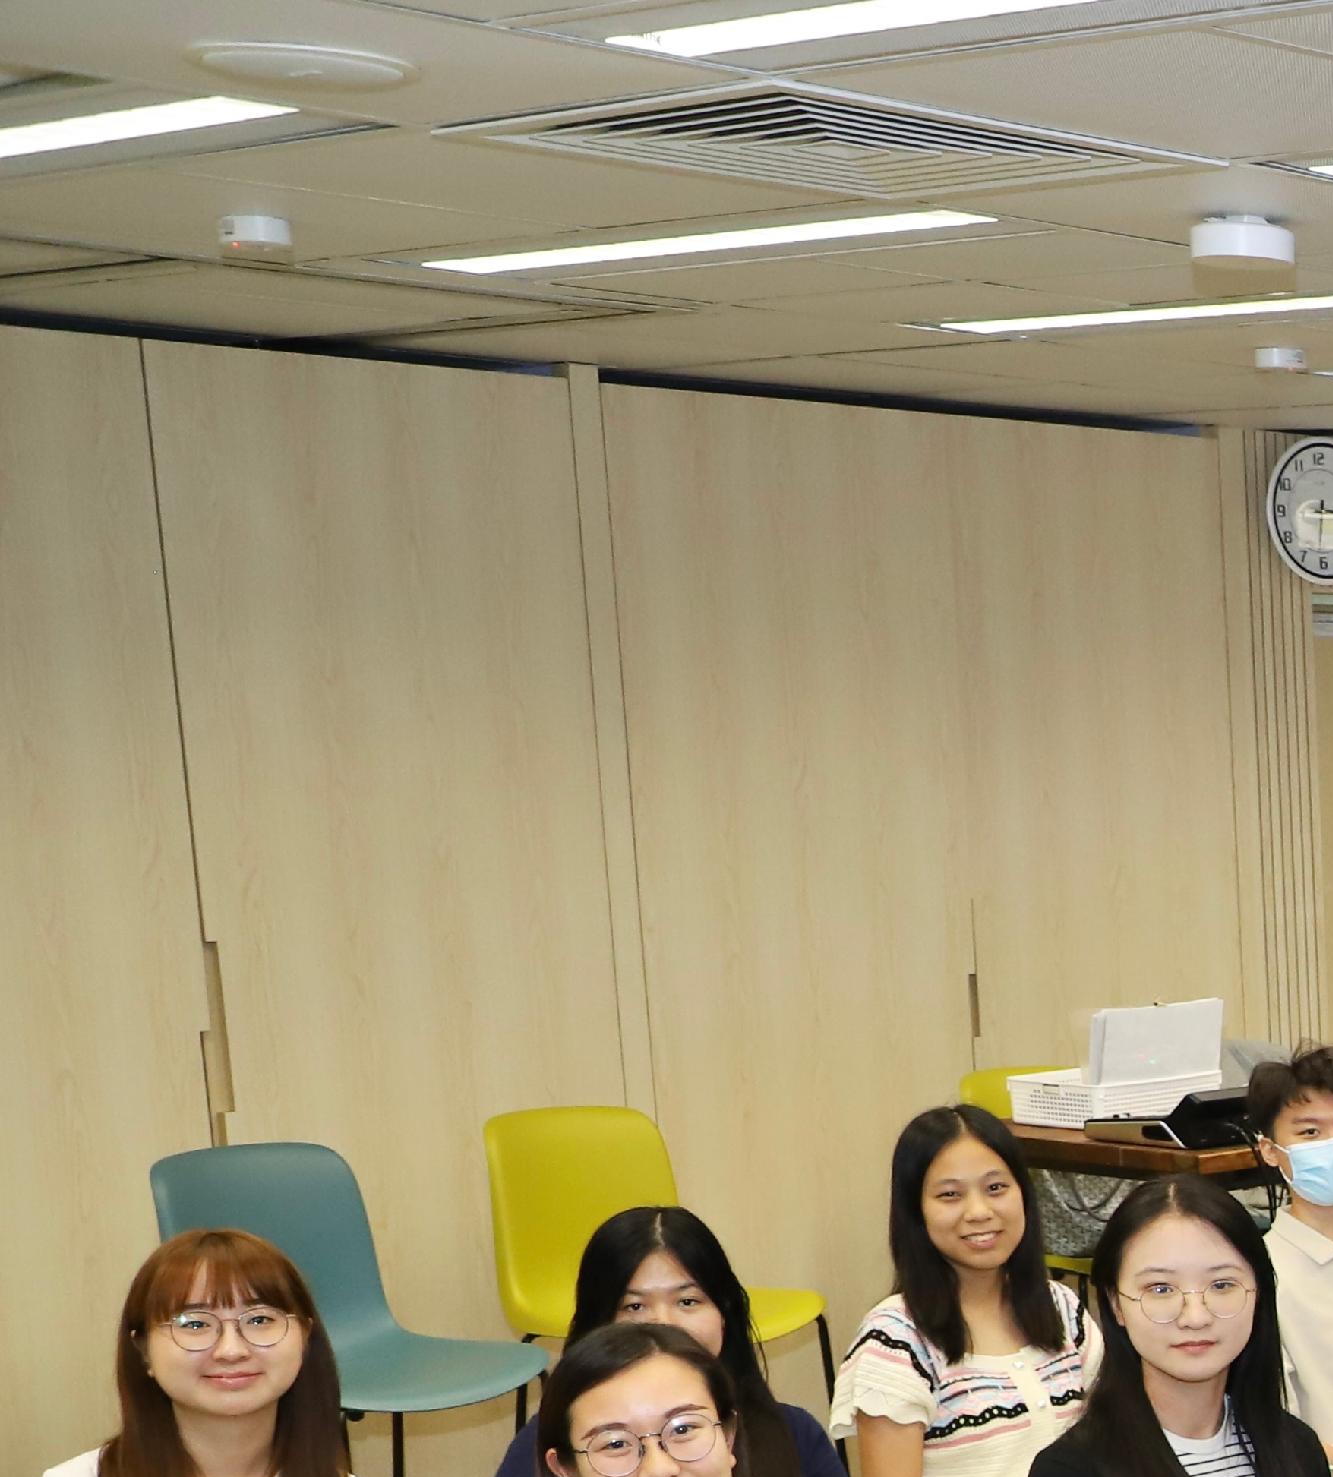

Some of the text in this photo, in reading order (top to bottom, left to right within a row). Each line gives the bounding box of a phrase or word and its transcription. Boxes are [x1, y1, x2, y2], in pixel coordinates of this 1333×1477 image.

[1313, 452, 1325, 465] 12
[1294, 460, 1304, 472] 11
[1279, 478, 1291, 491] 10
[1277, 504, 1286, 517] 9
[1283, 531, 1293, 544] 8
[1300, 551, 1308, 563] 7
[1319, 557, 1328, 570] 6
